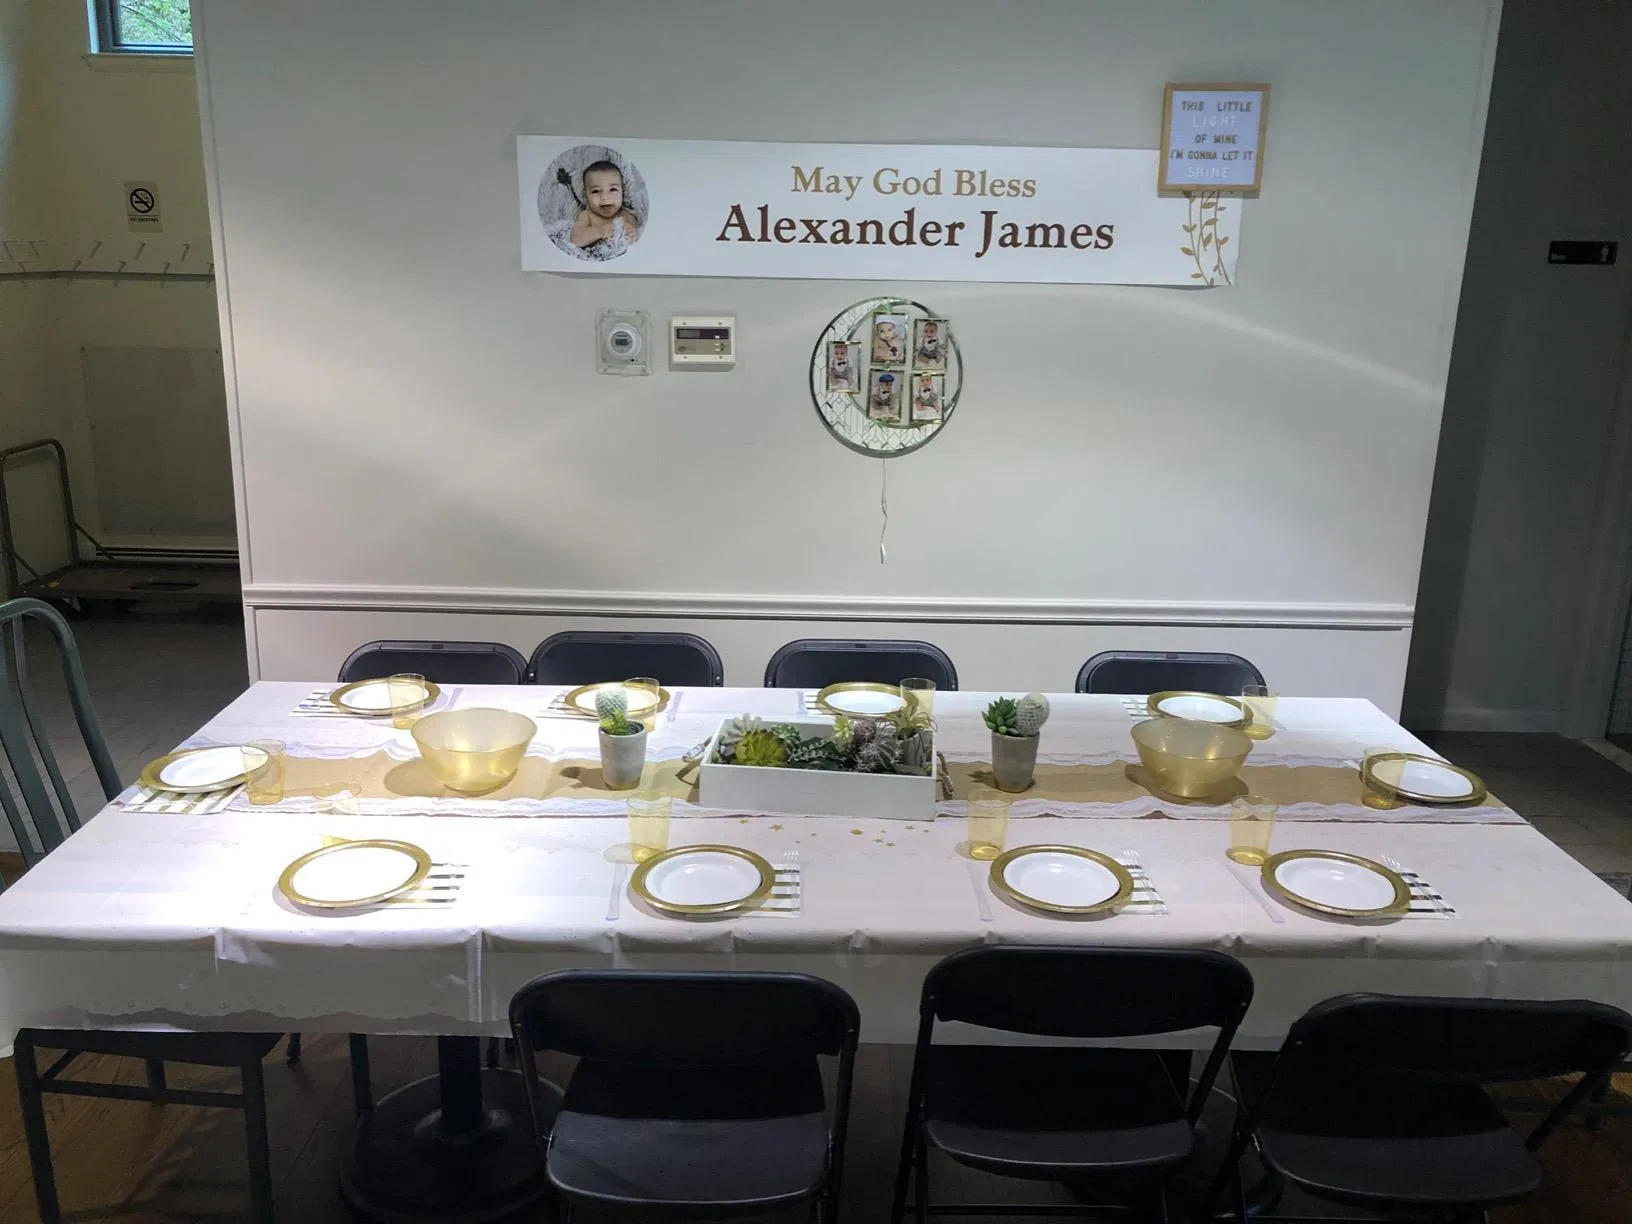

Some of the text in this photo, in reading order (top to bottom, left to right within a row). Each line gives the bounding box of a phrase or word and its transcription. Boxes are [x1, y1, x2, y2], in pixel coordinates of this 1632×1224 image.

[1181, 101, 1253, 112] THIS LITTLE
[1192, 115, 1237, 128] LIGHT
[1194, 134, 1239, 144] OF MINE
[1170, 149, 1254, 161] I'M GONNA LET IT
[1187, 167, 1230, 178] SHINE
[791, 166, 1037, 201] May God Bless
[715, 204, 1114, 258] Alexander James
